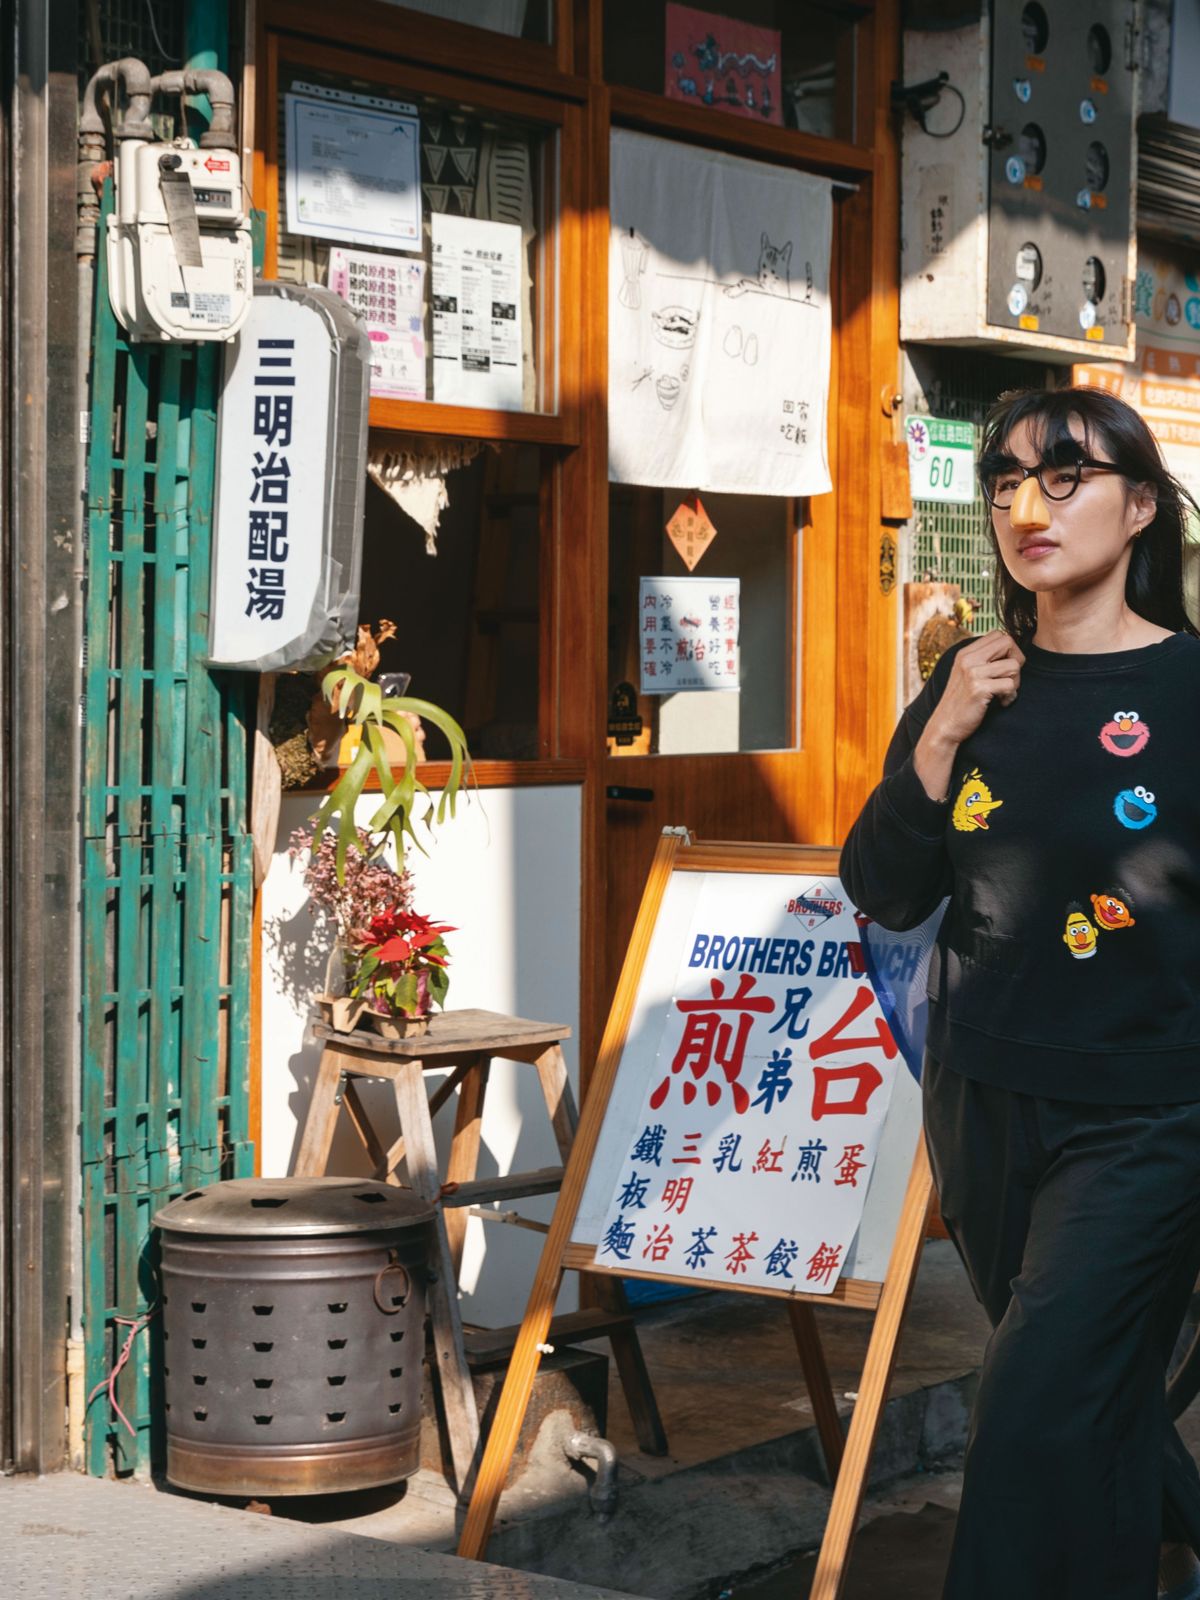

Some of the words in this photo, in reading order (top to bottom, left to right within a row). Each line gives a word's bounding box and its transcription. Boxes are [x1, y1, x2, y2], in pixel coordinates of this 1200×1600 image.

[355, 307, 397, 325] 肉原產地
[245, 339, 295, 620] 三明治配湯
[930, 456, 953, 488] 60
[688, 934, 814, 976] BROTHERS
[817, 940, 921, 983] BRNCH
[787, 898, 843, 917] BROTHERS
[601, 1125, 667, 1260] 鐵板麵
[642, 1133, 702, 1262] 三明治
[725, 1139, 784, 1273] 紅茶
[764, 1140, 828, 1278] 煎餃
[806, 1144, 868, 1286] 蛋餅
